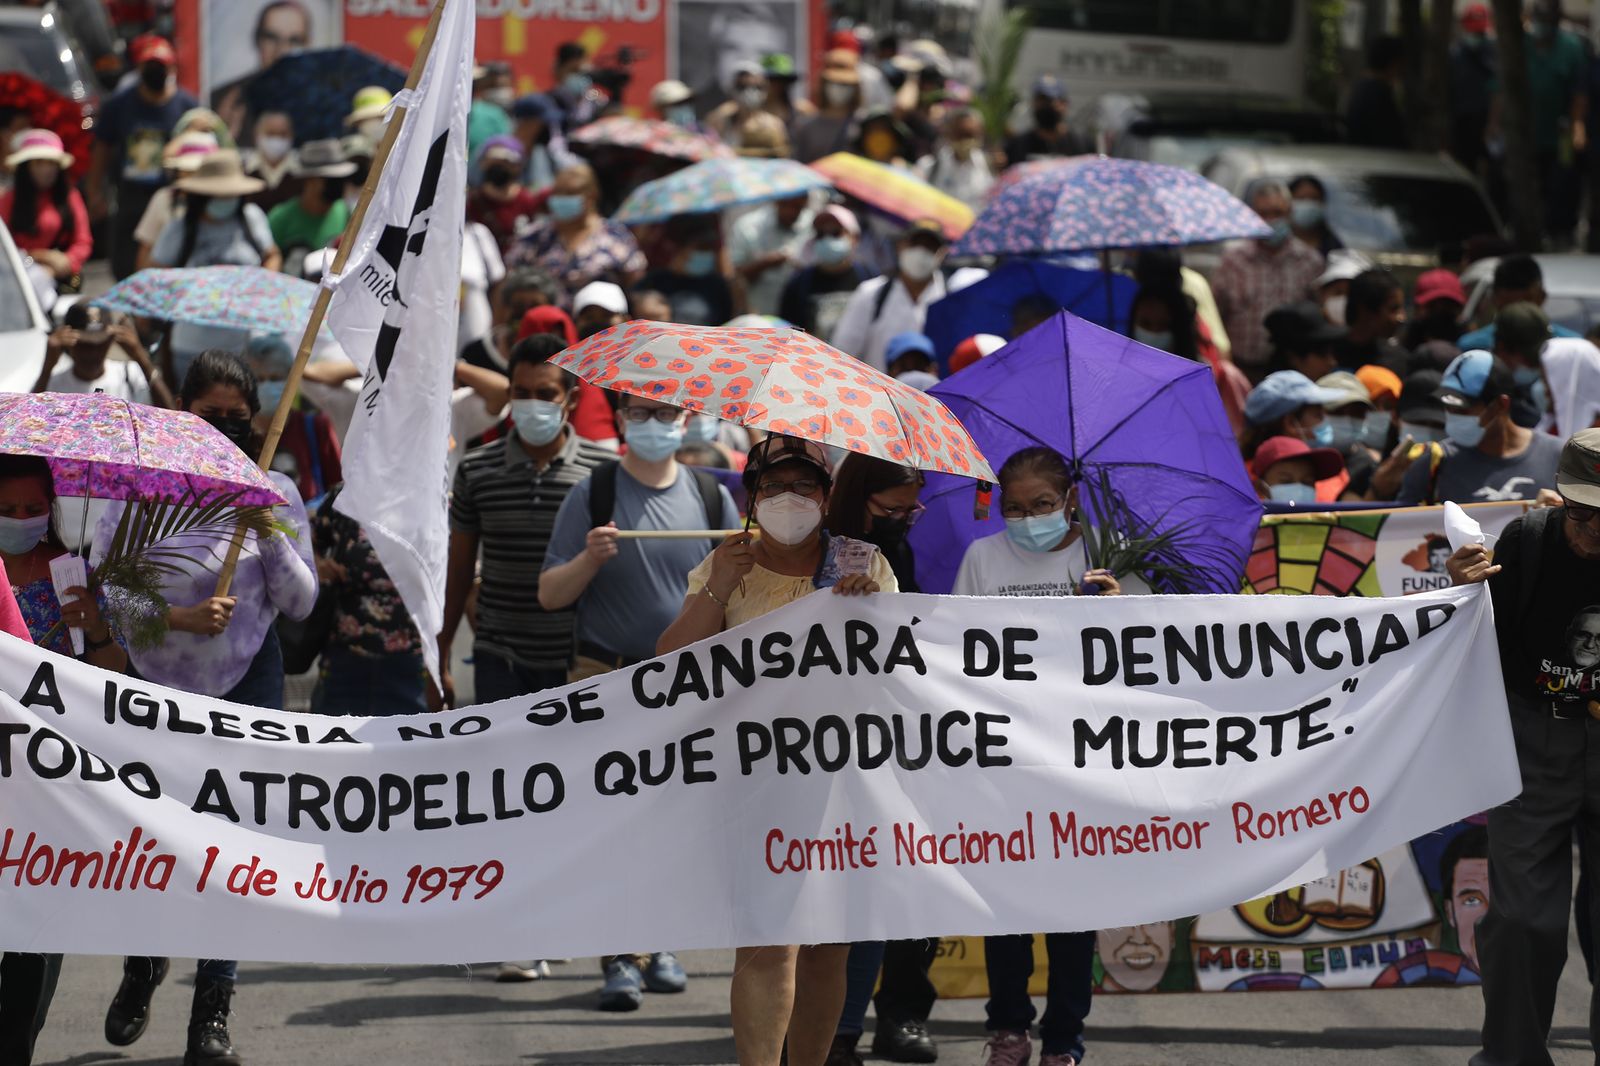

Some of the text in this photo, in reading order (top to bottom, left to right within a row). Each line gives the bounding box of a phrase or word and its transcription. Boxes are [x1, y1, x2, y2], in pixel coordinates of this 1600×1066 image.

[1007, 582, 1058, 592] ORGANIZACIÓN
[104, 680, 363, 744] IGLESIA
[398, 716, 491, 742] NO
[526, 683, 604, 726] SE
[632, 617, 926, 708] CANSARÁ
[963, 628, 1038, 680] DE
[1541, 659, 1571, 675] San
[0, 723, 161, 799] TODO
[191, 763, 564, 834] ATROPELLO
[595, 728, 717, 795] QUE
[737, 711, 1012, 775] PRODUCE
[0, 827, 504, 903] Homilía 1 de Julio 1979
[766, 787, 1369, 873] Comité Nacional Monseñor Romero
